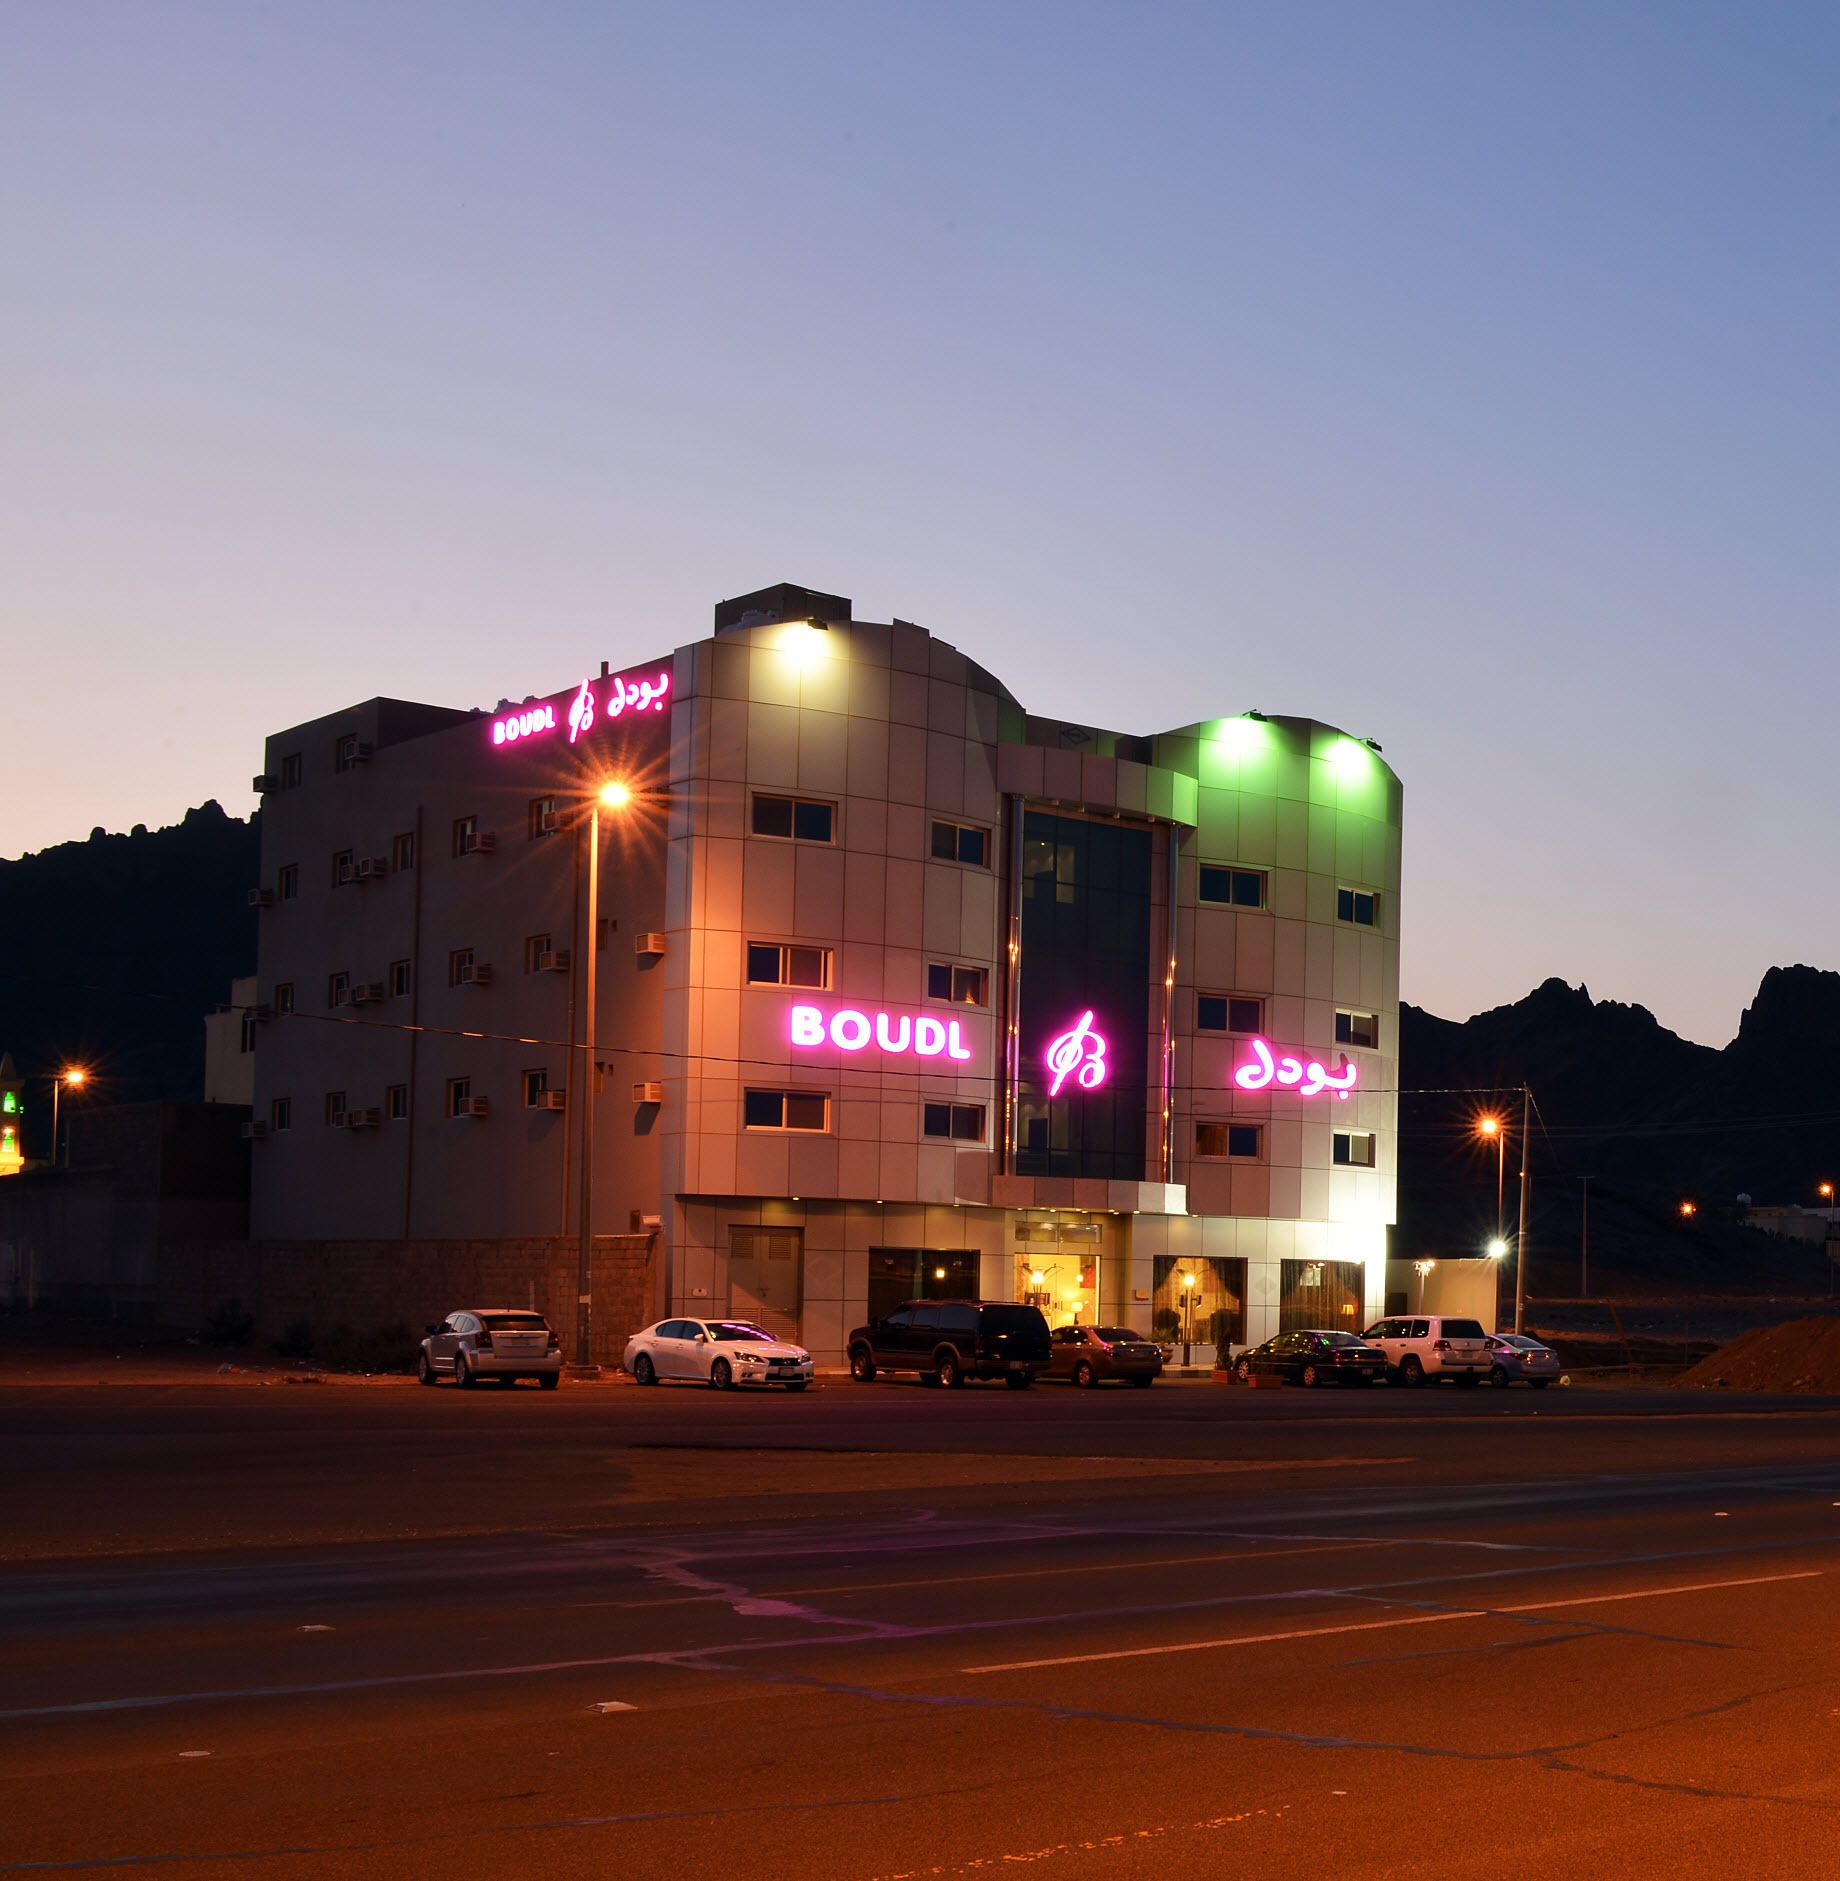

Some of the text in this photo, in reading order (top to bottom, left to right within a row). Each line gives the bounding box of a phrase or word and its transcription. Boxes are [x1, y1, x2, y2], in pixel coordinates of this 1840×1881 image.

[607, 673, 669, 717] بودل
[493, 705, 556, 745] BOUDL
[790, 1004, 972, 1060] BOUDL
[1234, 1039, 1359, 1101] بودل
